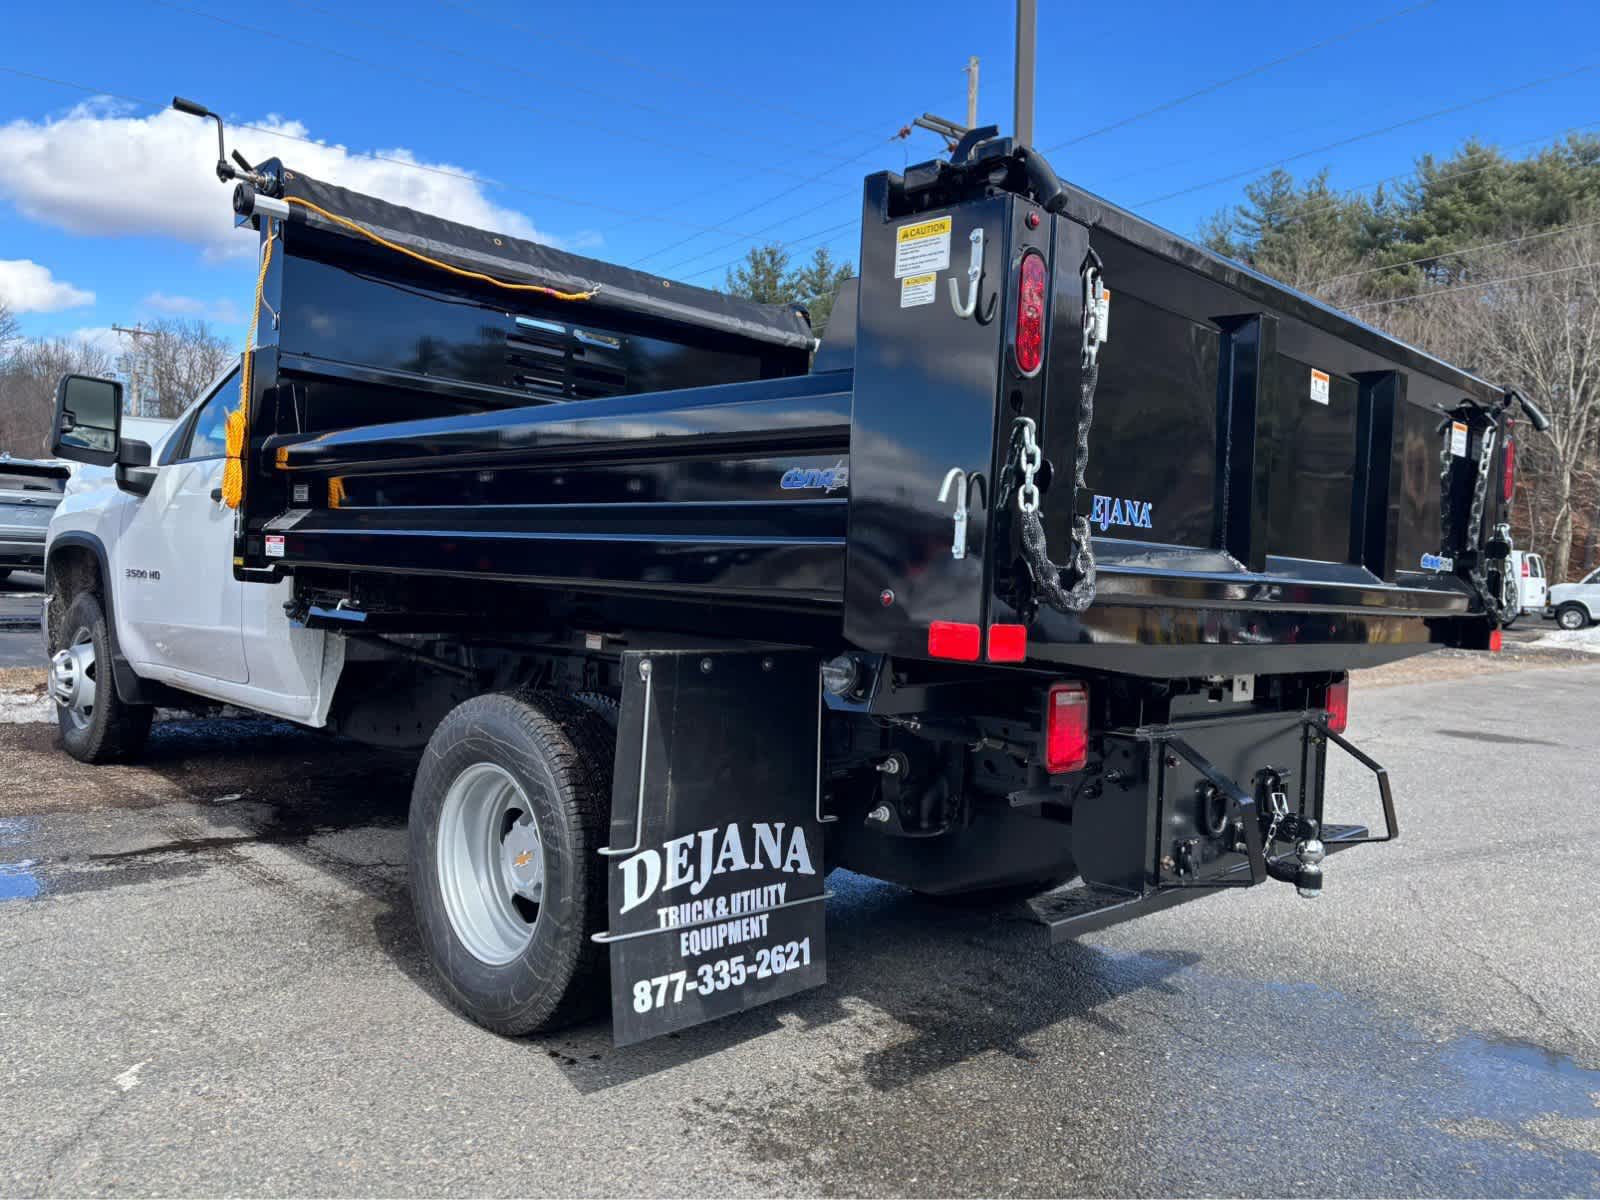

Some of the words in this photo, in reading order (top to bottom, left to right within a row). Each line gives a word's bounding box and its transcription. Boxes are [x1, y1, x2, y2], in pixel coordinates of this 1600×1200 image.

[910, 222, 945, 237] CAUTION
[1090, 495, 1152, 531] EJANA
[125, 568, 147, 579] 3500
[149, 570, 161, 581] HD
[618, 822, 816, 915] DEJANA
[657, 897, 714, 929] TRUCK
[731, 883, 786, 914] UTILITY
[681, 914, 769, 957] EQUIPMENT
[633, 936, 811, 1014] 877-335-2621
